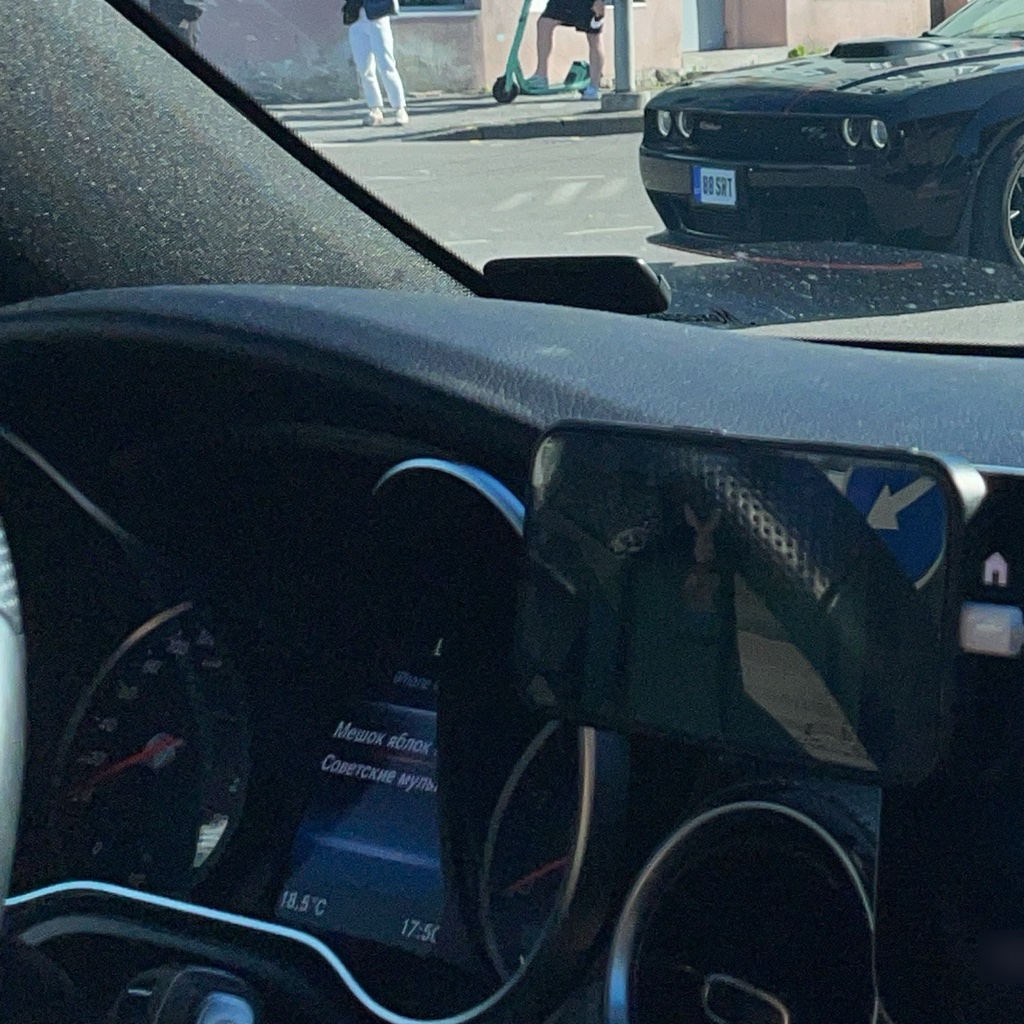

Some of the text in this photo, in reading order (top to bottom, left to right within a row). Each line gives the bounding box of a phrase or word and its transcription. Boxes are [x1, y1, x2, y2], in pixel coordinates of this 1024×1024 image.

[715, 176, 733, 197] SRT
[331, 720, 433, 756] Мешок яблок
[320, 753, 397, 784] Советские
